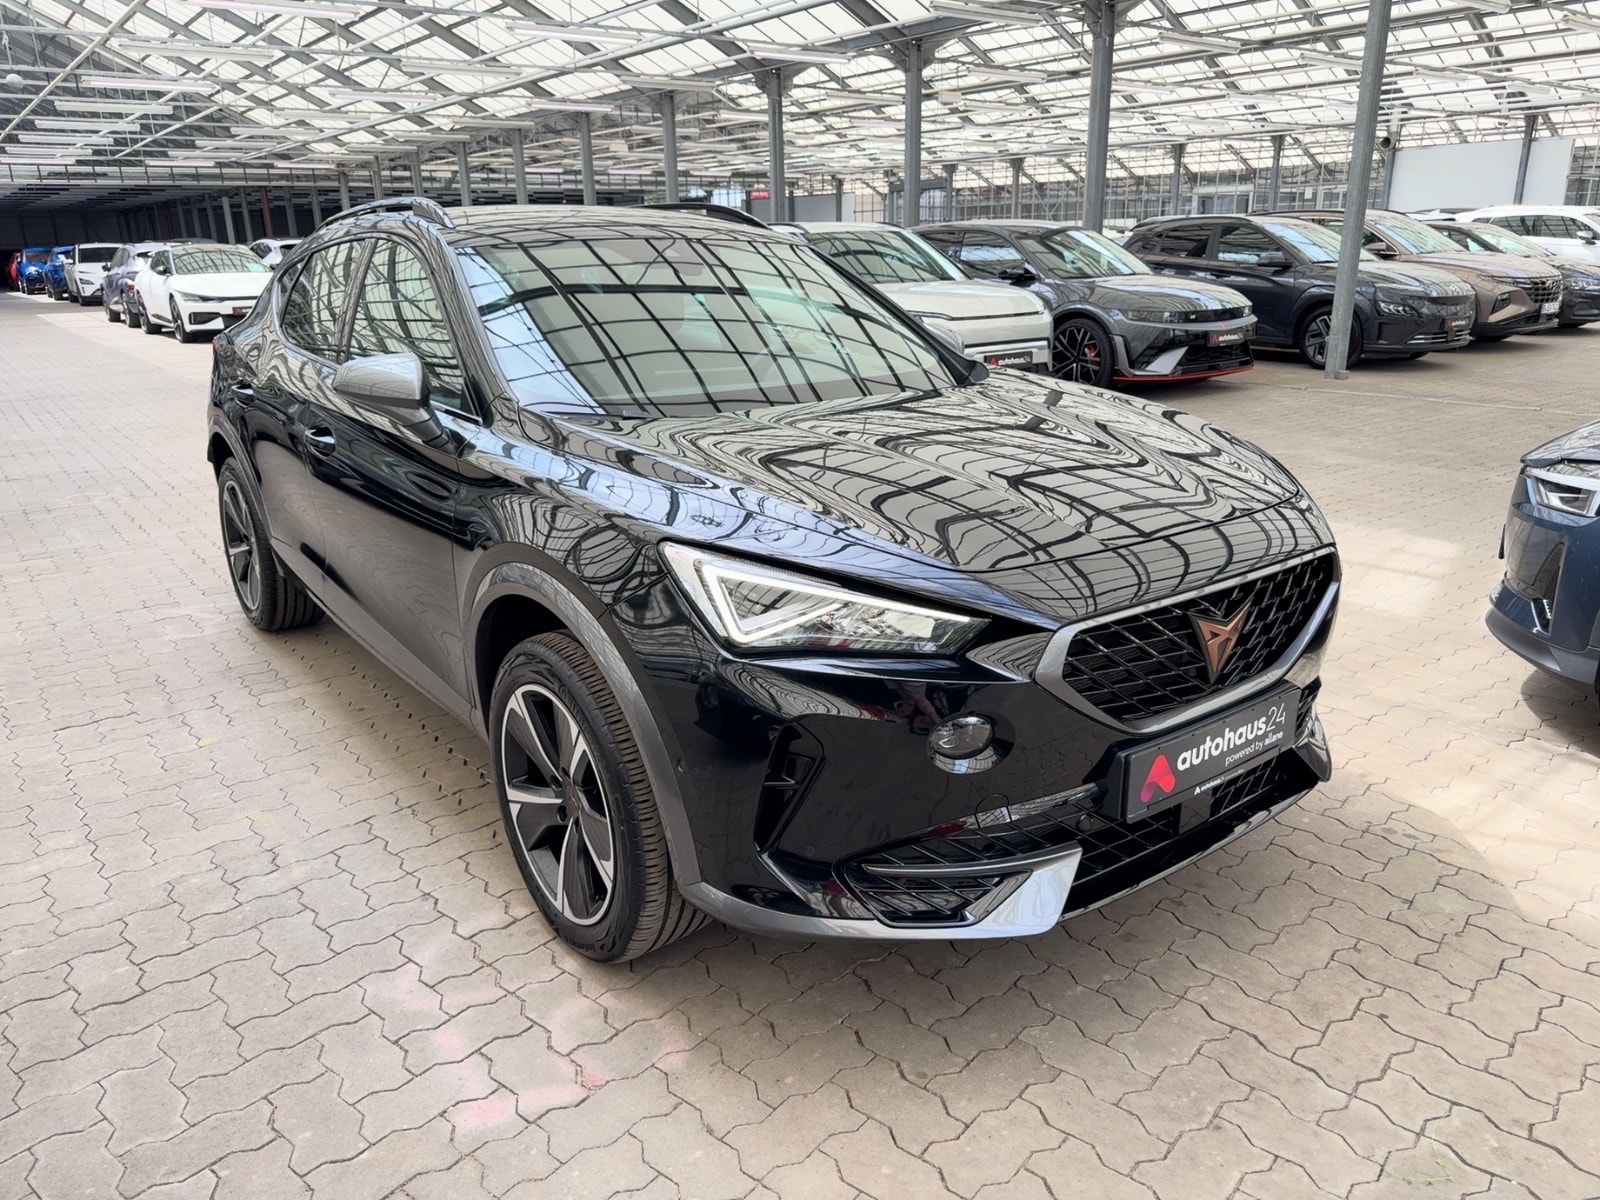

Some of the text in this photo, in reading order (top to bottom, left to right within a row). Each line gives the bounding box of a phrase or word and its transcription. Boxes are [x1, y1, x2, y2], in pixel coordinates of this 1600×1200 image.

[1177, 702, 1286, 771] autohaus24
[1225, 731, 1284, 767] powered by allane
